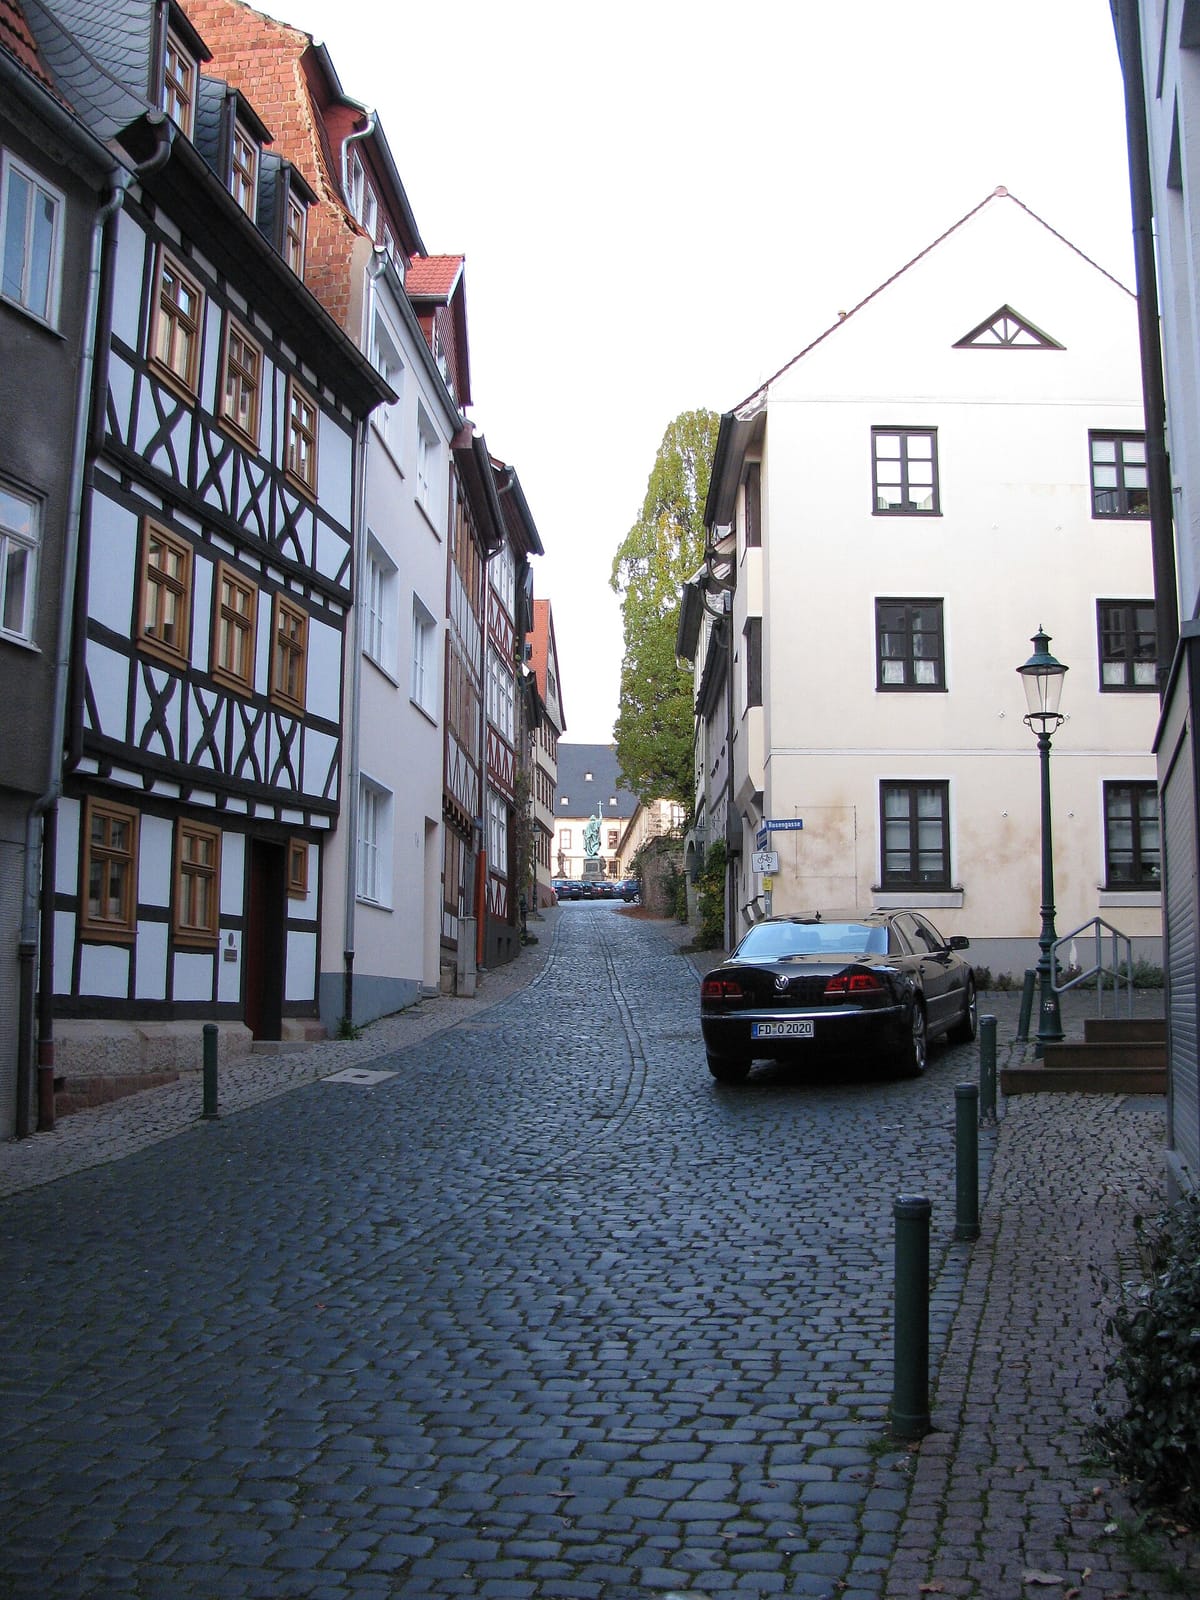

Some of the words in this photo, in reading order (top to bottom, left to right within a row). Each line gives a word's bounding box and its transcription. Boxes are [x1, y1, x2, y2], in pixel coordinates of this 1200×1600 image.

[768, 822, 801, 830] Rosengasse
[758, 1025, 772, 1034] FD
[786, 1024, 812, 1034] 2020
